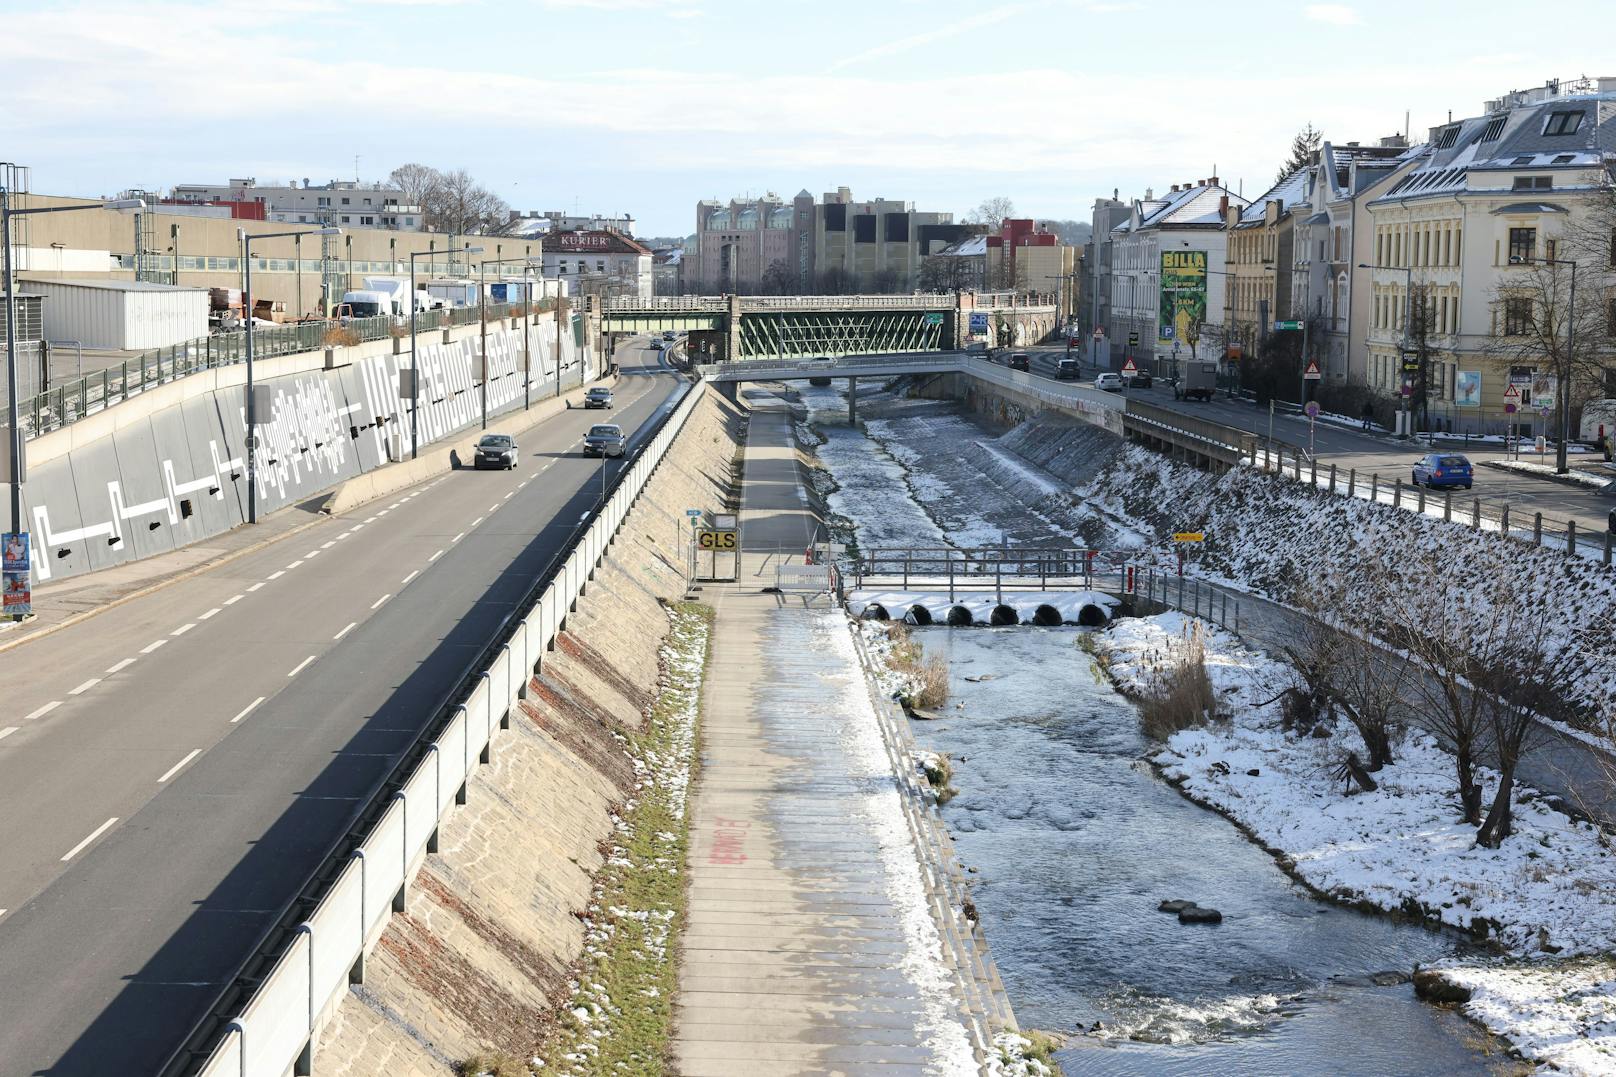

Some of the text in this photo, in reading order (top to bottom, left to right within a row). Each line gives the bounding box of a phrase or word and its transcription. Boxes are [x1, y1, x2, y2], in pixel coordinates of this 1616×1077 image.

[561, 236, 607, 245] KURIER
[1163, 253, 1205, 267] BILLA
[1165, 327, 1172, 336] P
[700, 533, 735, 548] GLS
